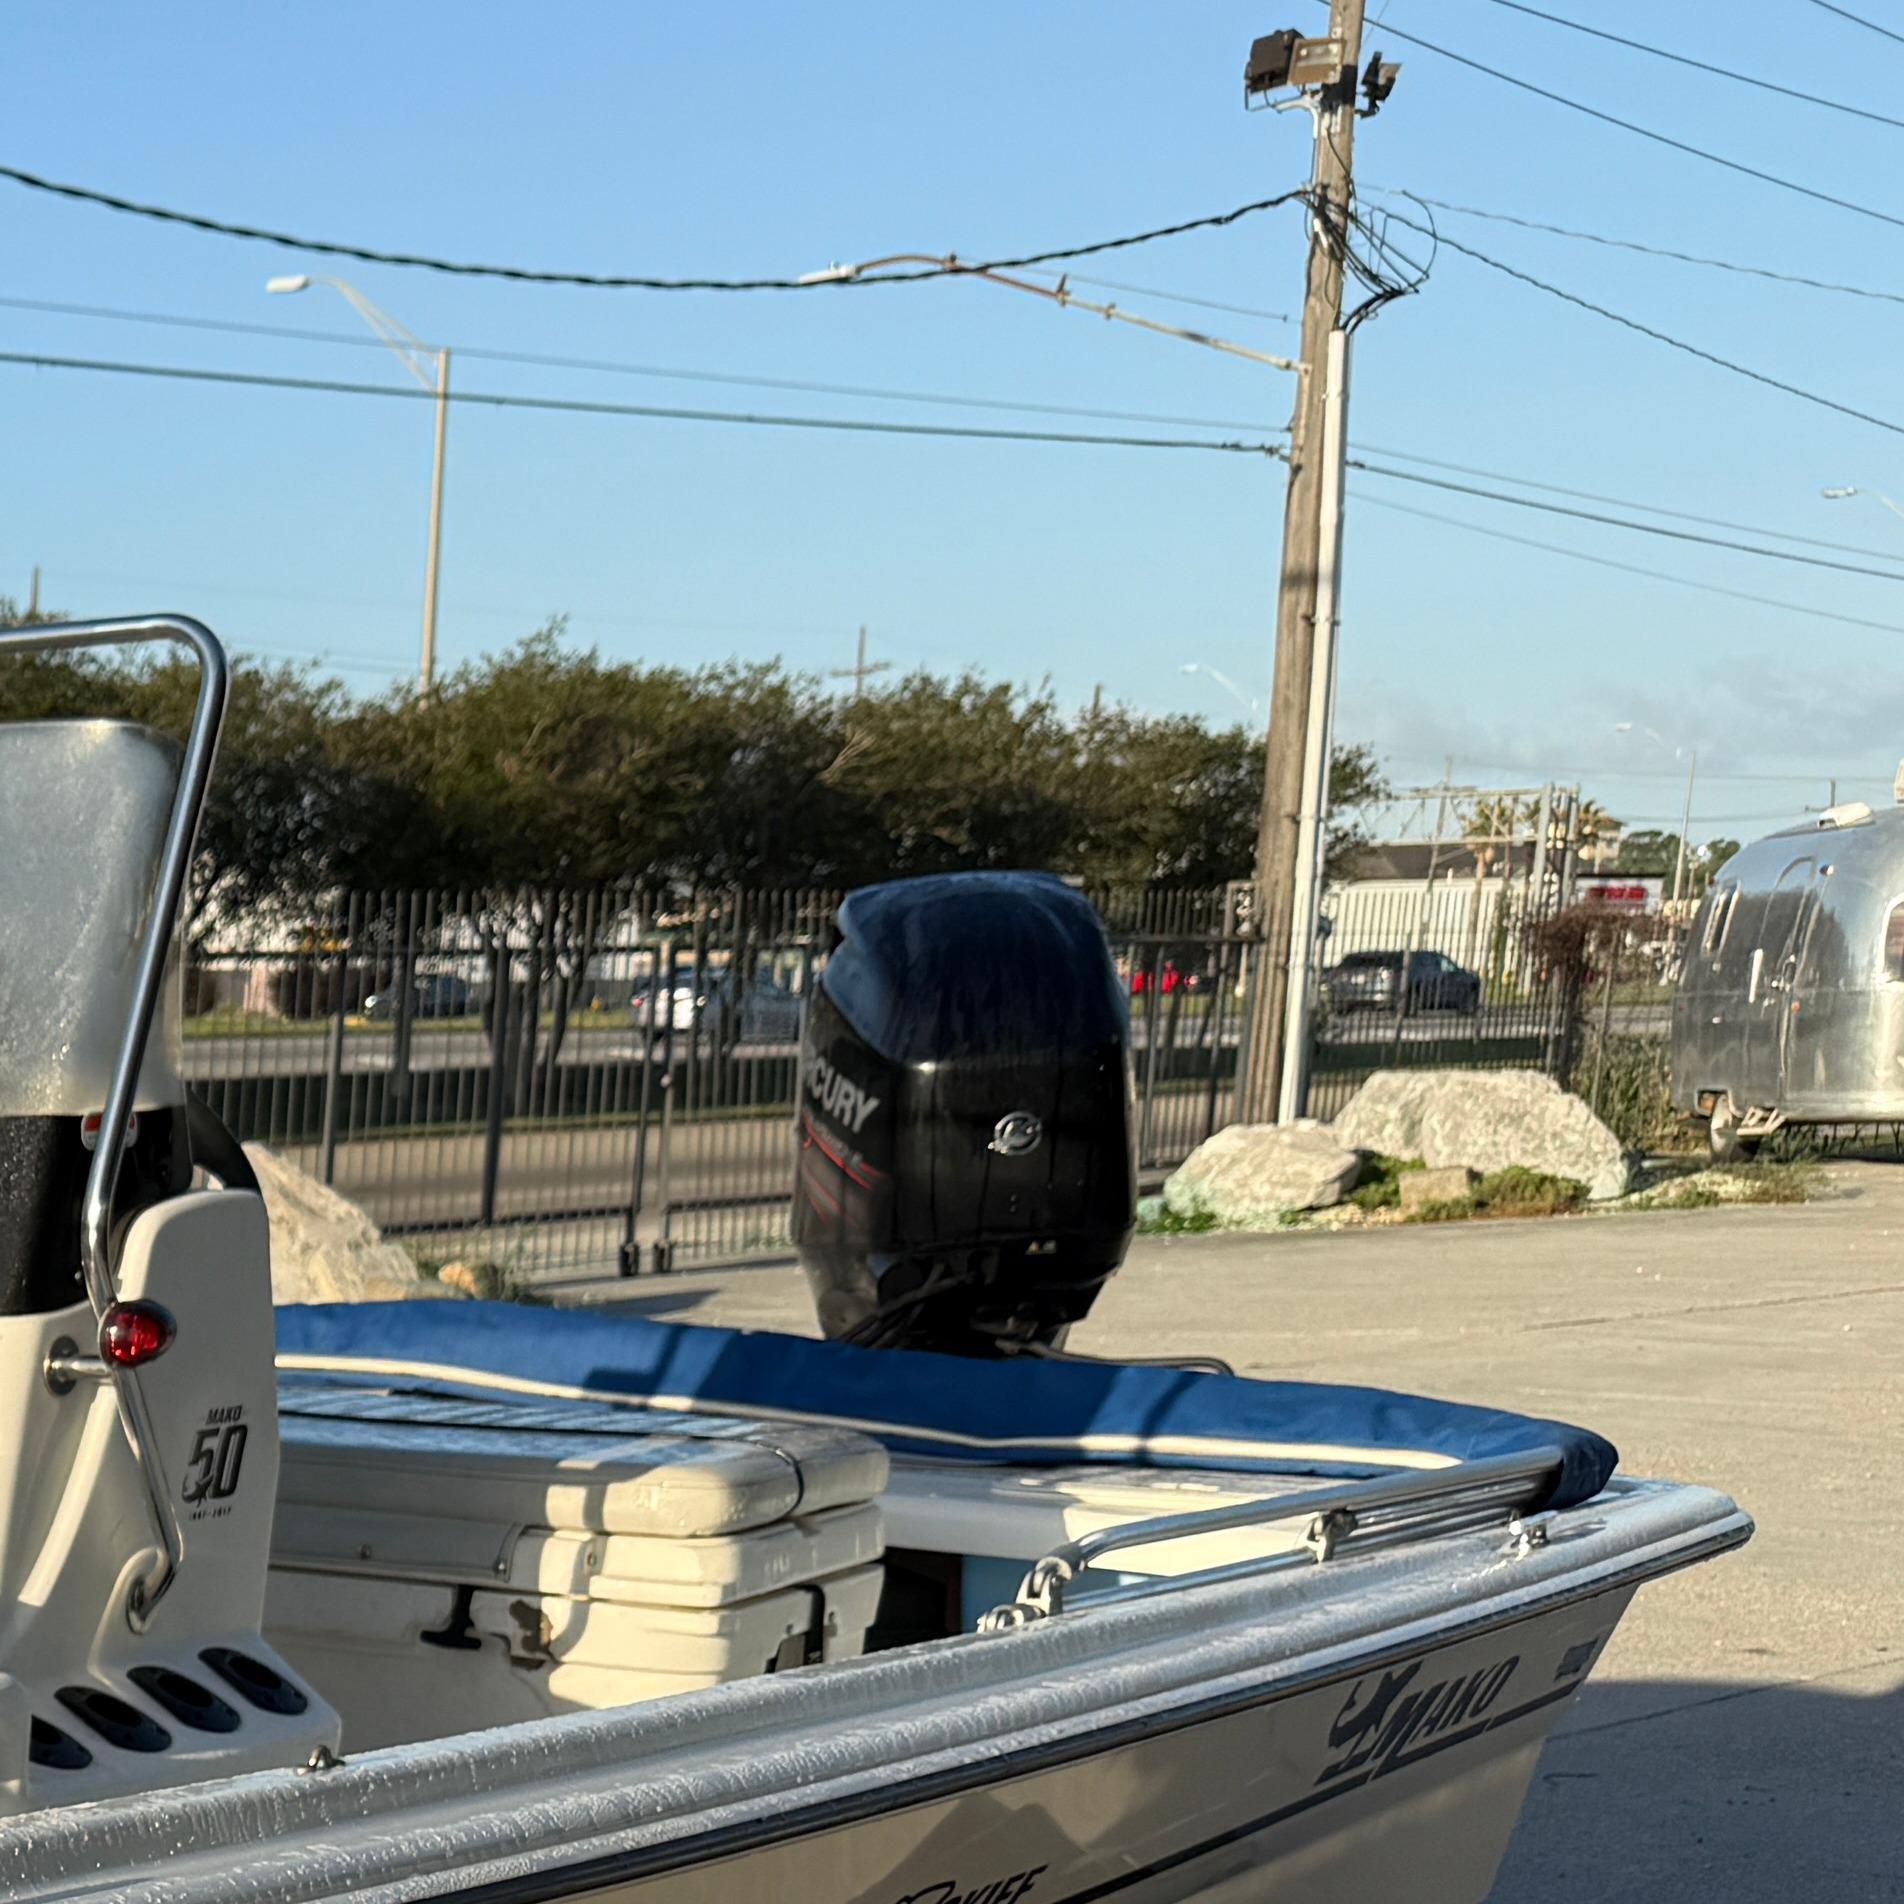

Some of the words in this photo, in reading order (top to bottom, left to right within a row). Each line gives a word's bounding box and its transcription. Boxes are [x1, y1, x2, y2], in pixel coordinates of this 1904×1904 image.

[805, 1045, 880, 1134] CURY
[182, 1424, 248, 1501] 50
[1372, 1656, 1521, 1770] MAKO
